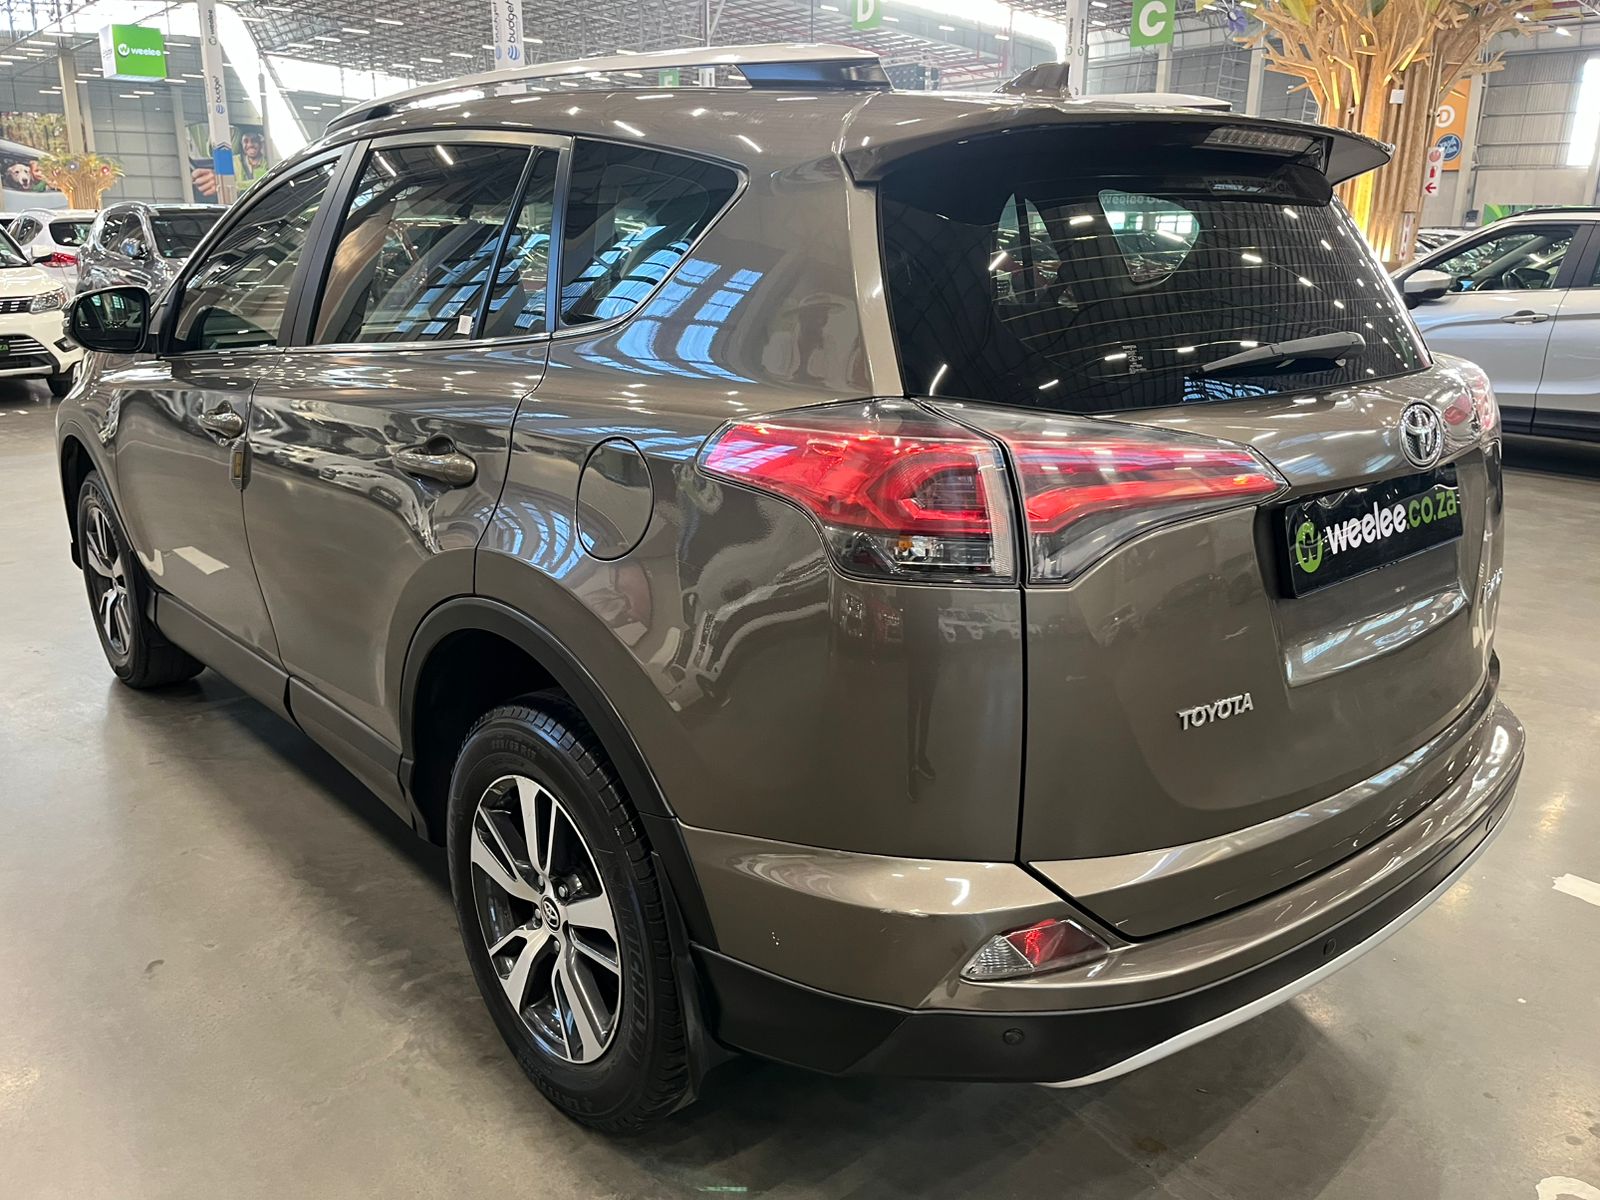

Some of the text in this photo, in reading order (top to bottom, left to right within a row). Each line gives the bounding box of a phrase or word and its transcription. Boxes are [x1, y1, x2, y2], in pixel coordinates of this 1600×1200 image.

[505, 0, 518, 43] budget
[1139, 1, 1167, 36] C
[130, 47, 162, 57] weelee
[1325, 490, 1457, 555] weelee.co.za
[1177, 692, 1254, 730] TOYOTA
